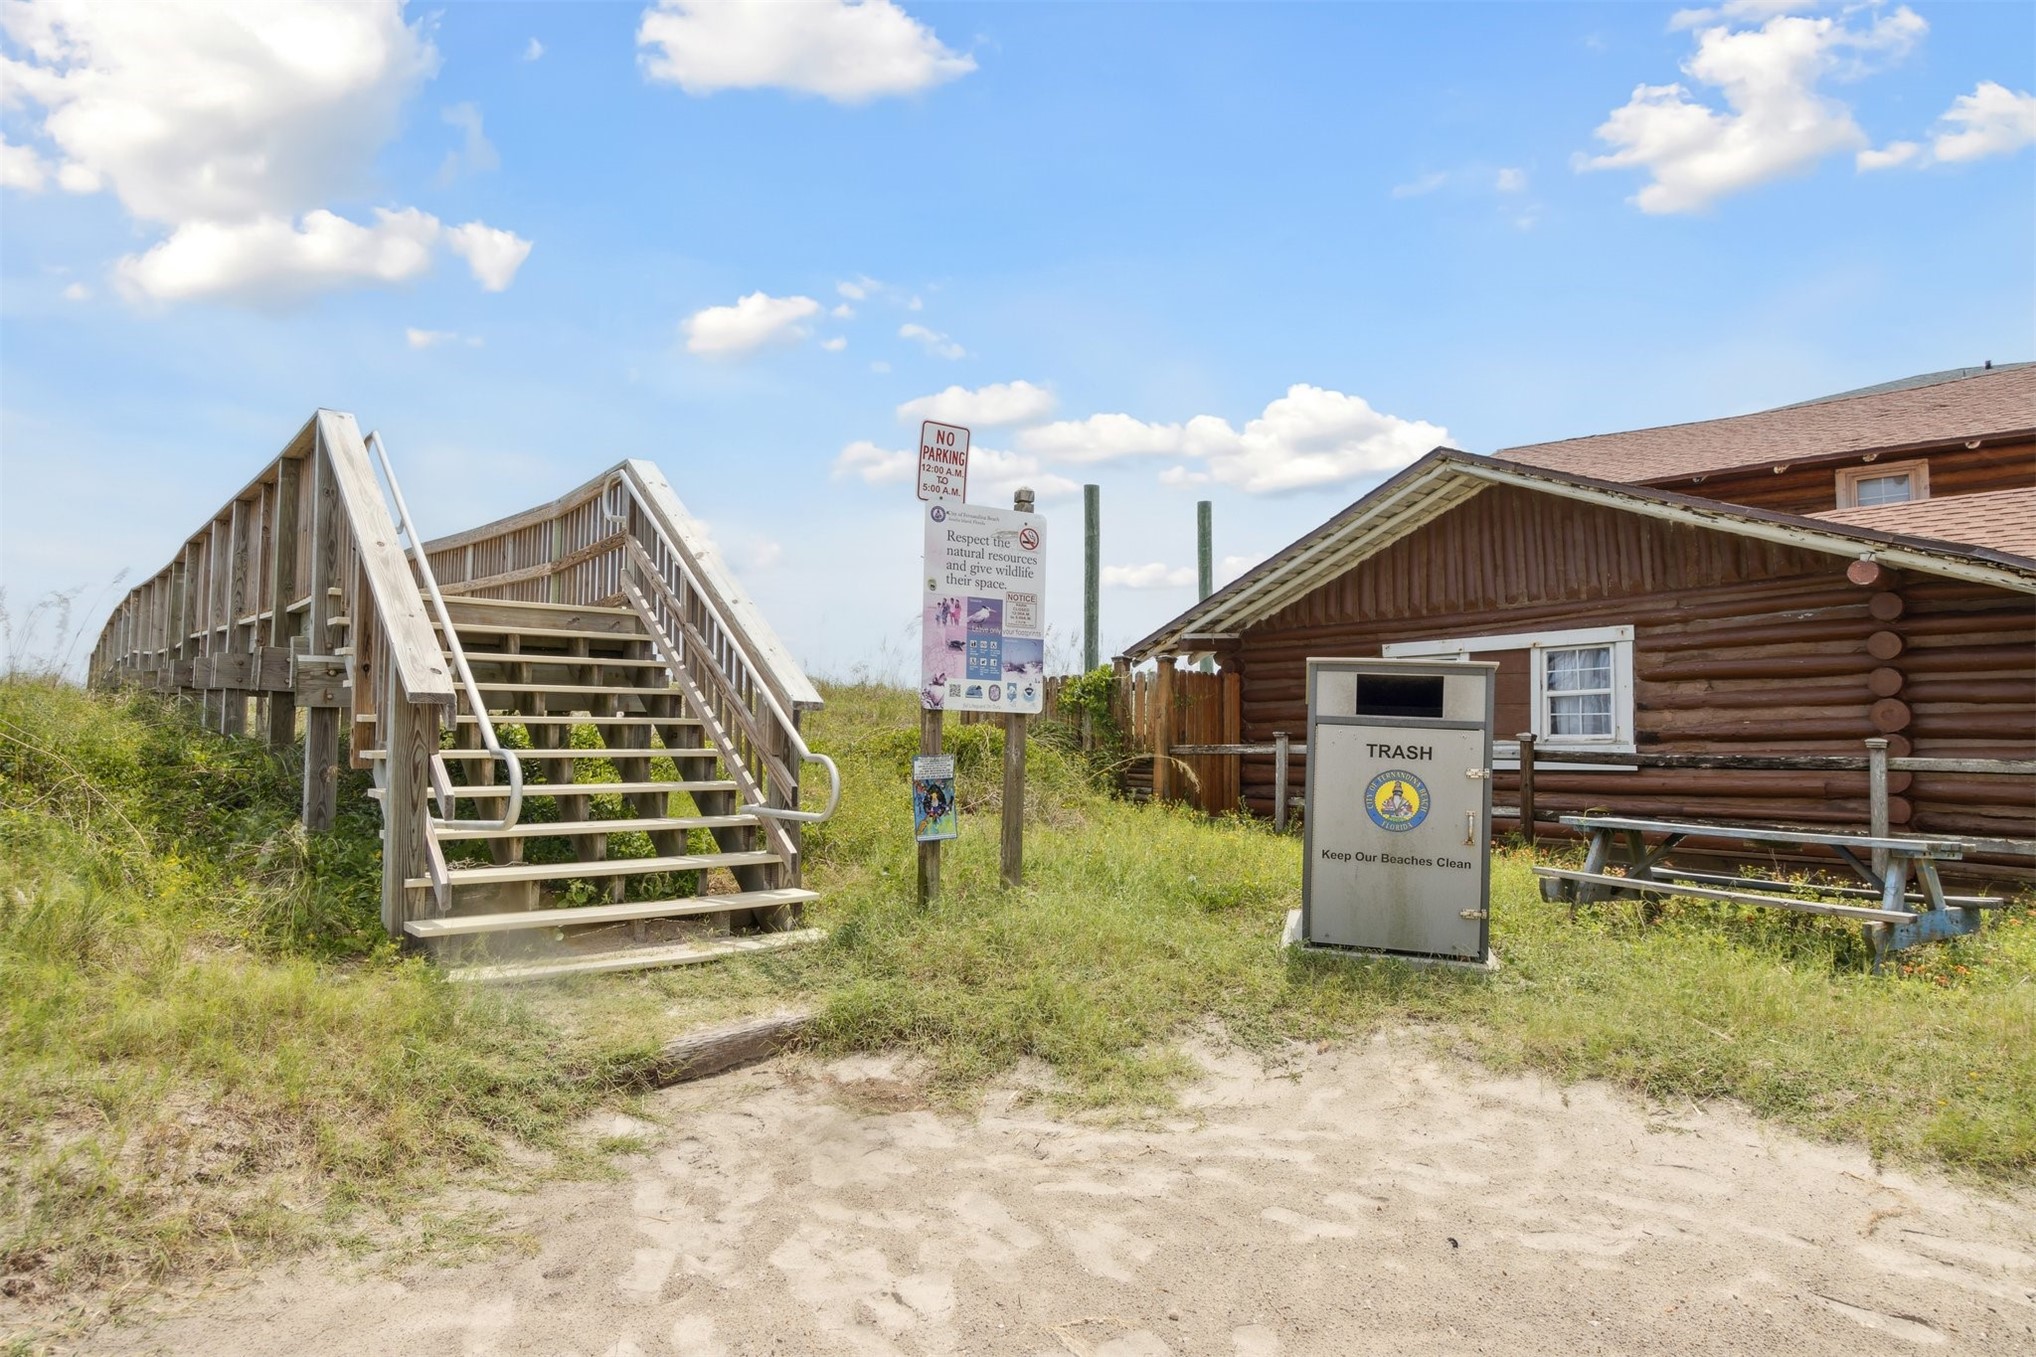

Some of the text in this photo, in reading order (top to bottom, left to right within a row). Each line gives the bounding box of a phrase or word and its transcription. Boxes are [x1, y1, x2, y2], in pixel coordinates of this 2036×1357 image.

[936, 430, 955, 446] NO
[923, 445, 965, 466] PARKING
[922, 464, 964, 478] 12:00 A.M.
[936, 476, 948, 485] TO
[923, 483, 960, 496] 5:00 A.M.
[947, 530, 1010, 548] Respect the
[946, 546, 1038, 565] natural resources
[946, 560, 1034, 578] and give wildlife
[946, 573, 1007, 590] their space.
[1007, 593, 1035, 602] NOTICE
[1366, 744, 1432, 760] TRASH
[1370, 782, 1378, 791] OF
[1378, 772, 1421, 788] FERNANDINA
[1420, 788, 1428, 812] BEACH
[1381, 820, 1413, 830] FLORIDA
[1322, 849, 1472, 869] Keep Our Beaches Clean
